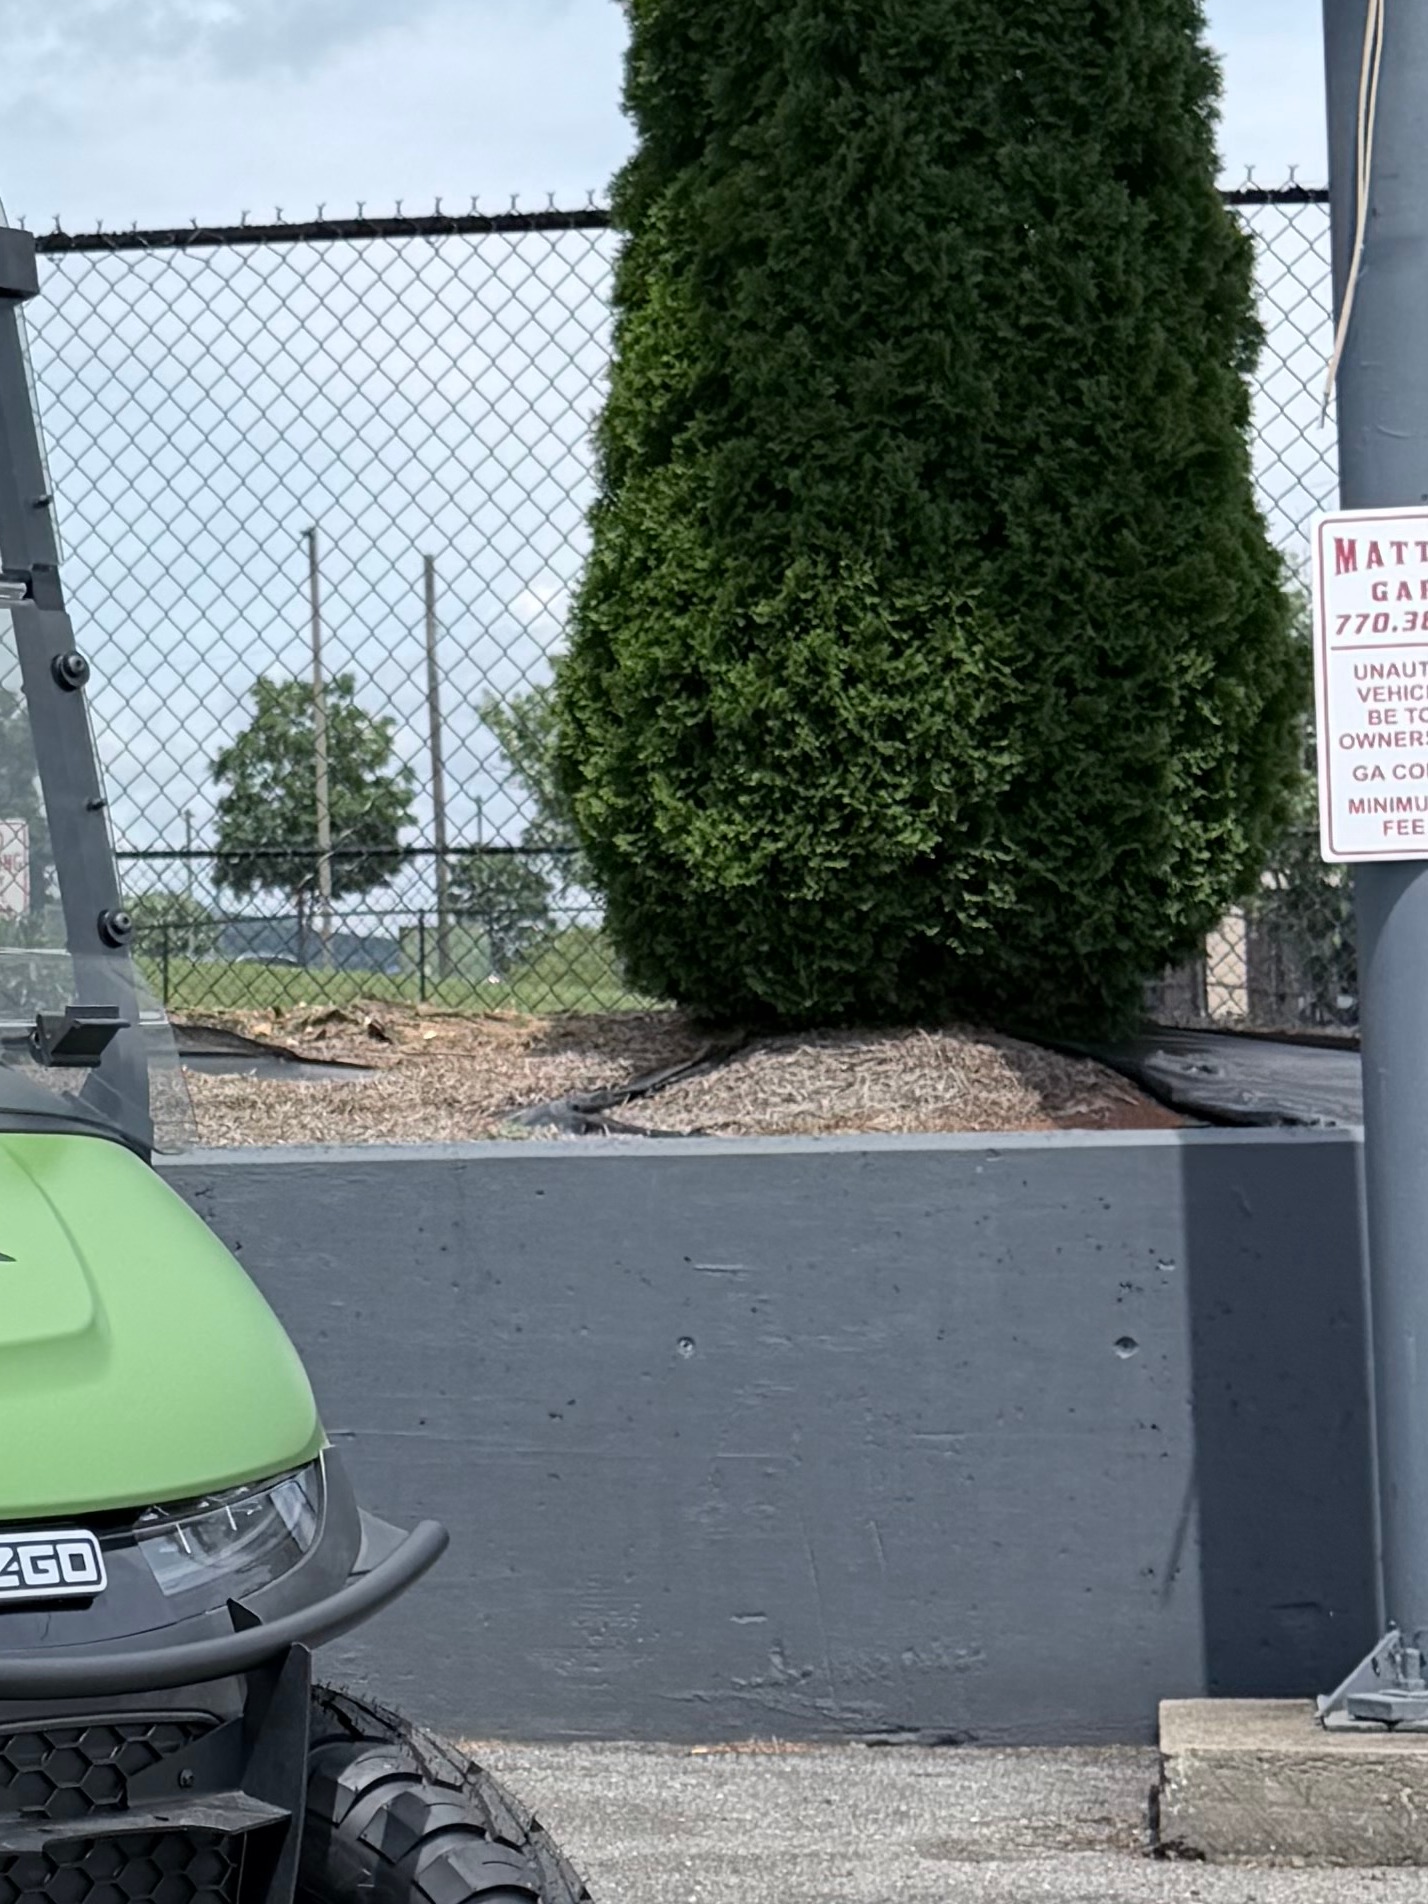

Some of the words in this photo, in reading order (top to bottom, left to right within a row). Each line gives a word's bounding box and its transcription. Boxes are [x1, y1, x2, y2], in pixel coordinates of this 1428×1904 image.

[1334, 536, 1428, 576] MATT
[1354, 661, 1428, 681] UNAUT
[1357, 684, 1428, 703] VEHIC
[1368, 708, 1398, 725] BE
[1339, 730, 1428, 750] OWNER
[1352, 764, 1386, 782] GA
[1348, 795, 1428, 815] MINIMU
[1383, 819, 1425, 837] FEE
